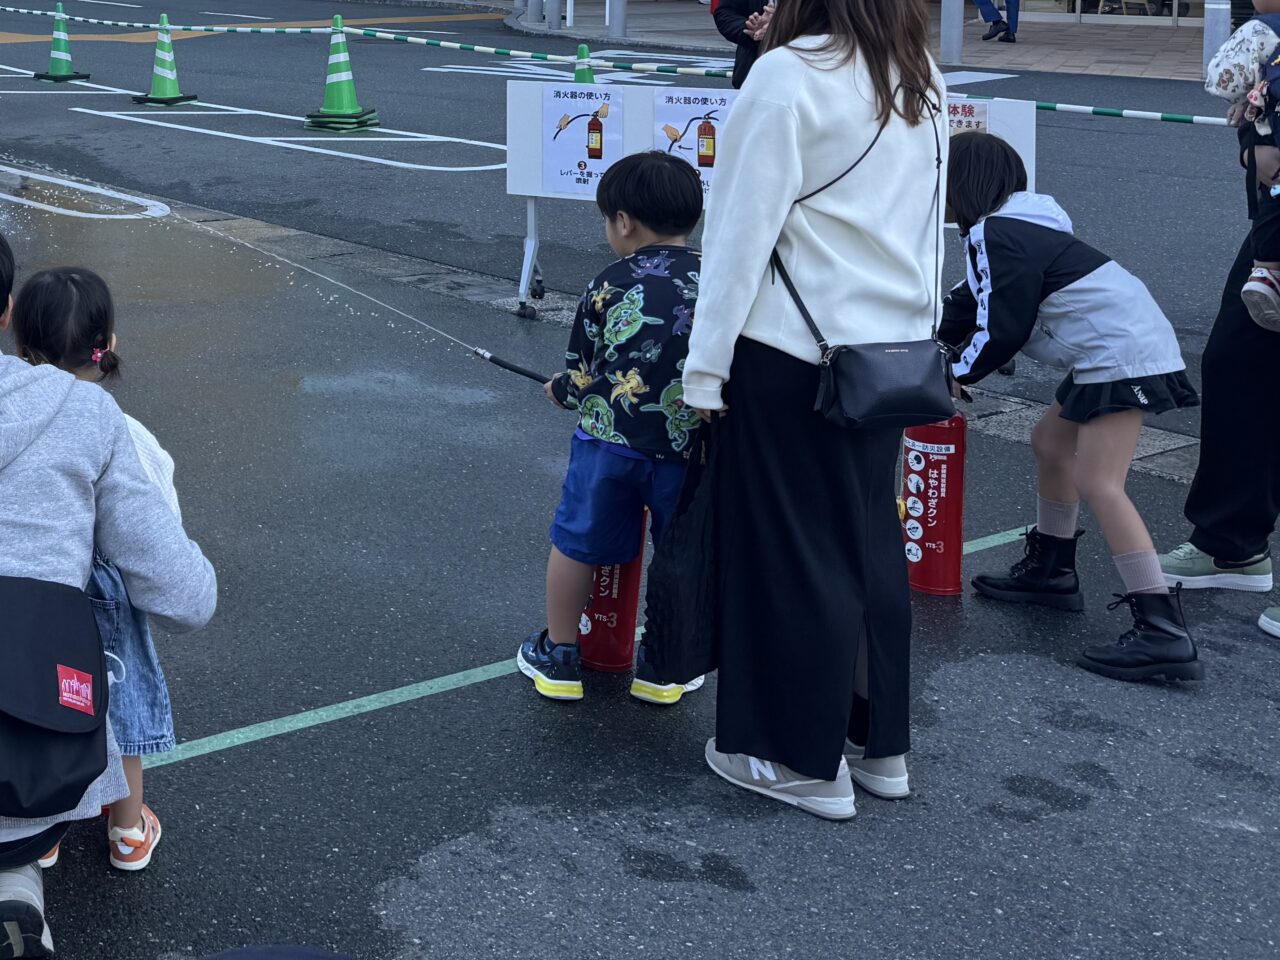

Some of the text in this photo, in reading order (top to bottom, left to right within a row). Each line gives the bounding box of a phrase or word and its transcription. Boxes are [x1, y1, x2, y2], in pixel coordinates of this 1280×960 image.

[553, 90, 611, 101] 消火器の使い方
[665, 95, 727, 107] 消火器の使い方
[927, 468, 939, 527] はやわざクン
[594, 611, 618, 628] YTS-3
